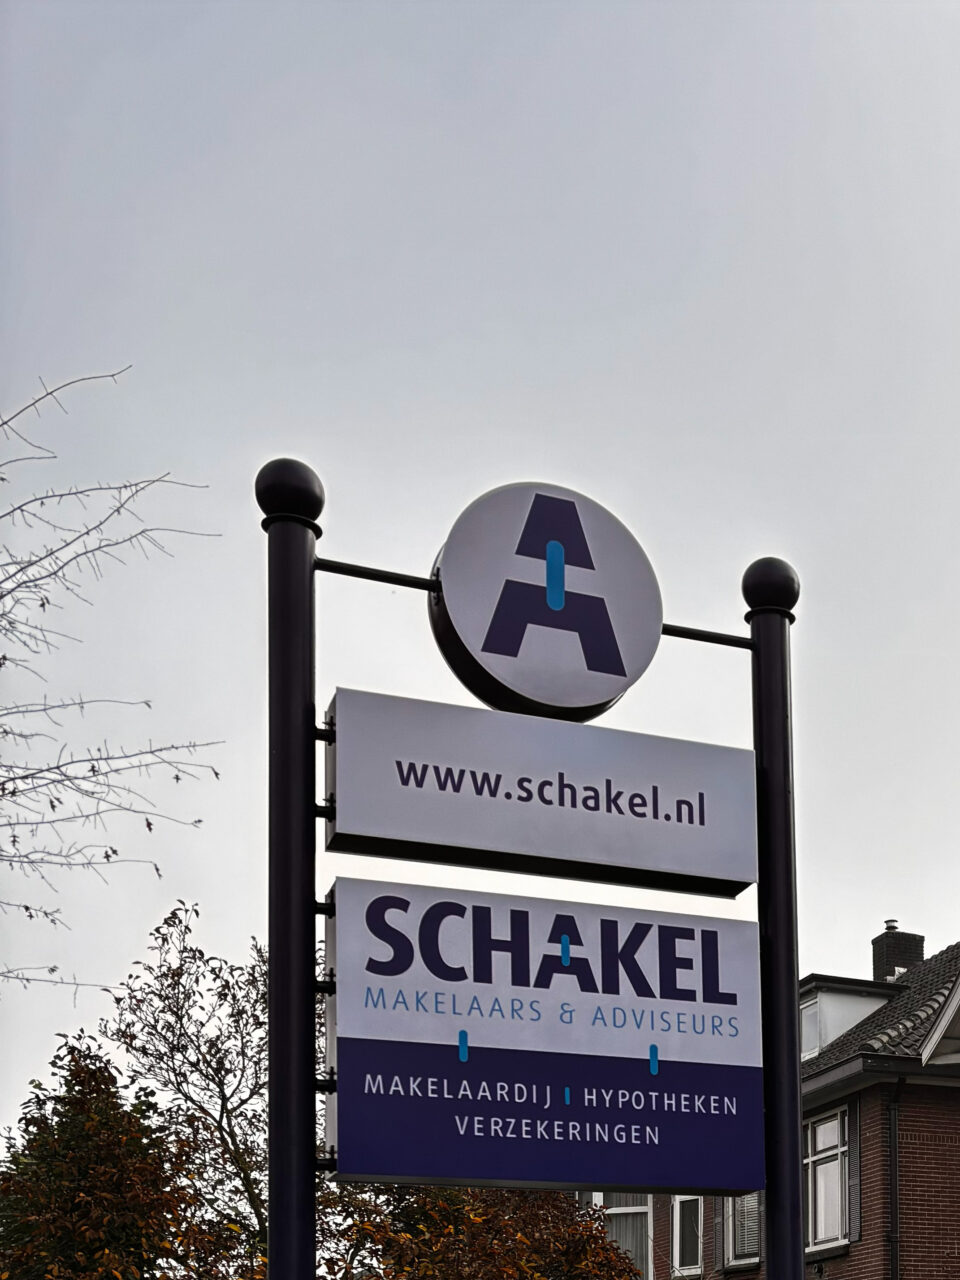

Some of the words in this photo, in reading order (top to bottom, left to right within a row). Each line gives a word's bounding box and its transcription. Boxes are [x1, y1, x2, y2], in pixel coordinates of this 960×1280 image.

[395, 760, 706, 826] www.schakel.nl
[365, 894, 738, 1006] SCHAKEL
[364, 986, 542, 1022] MAKELAARS
[559, 1002, 576, 1025] &
[591, 1005, 740, 1038] ADVISEURS
[364, 1073, 551, 1110] MAKELAARDIJ
[584, 1087, 738, 1116] HYPOTHEKEN
[455, 1115, 660, 1145] VERZEKERINGEN
